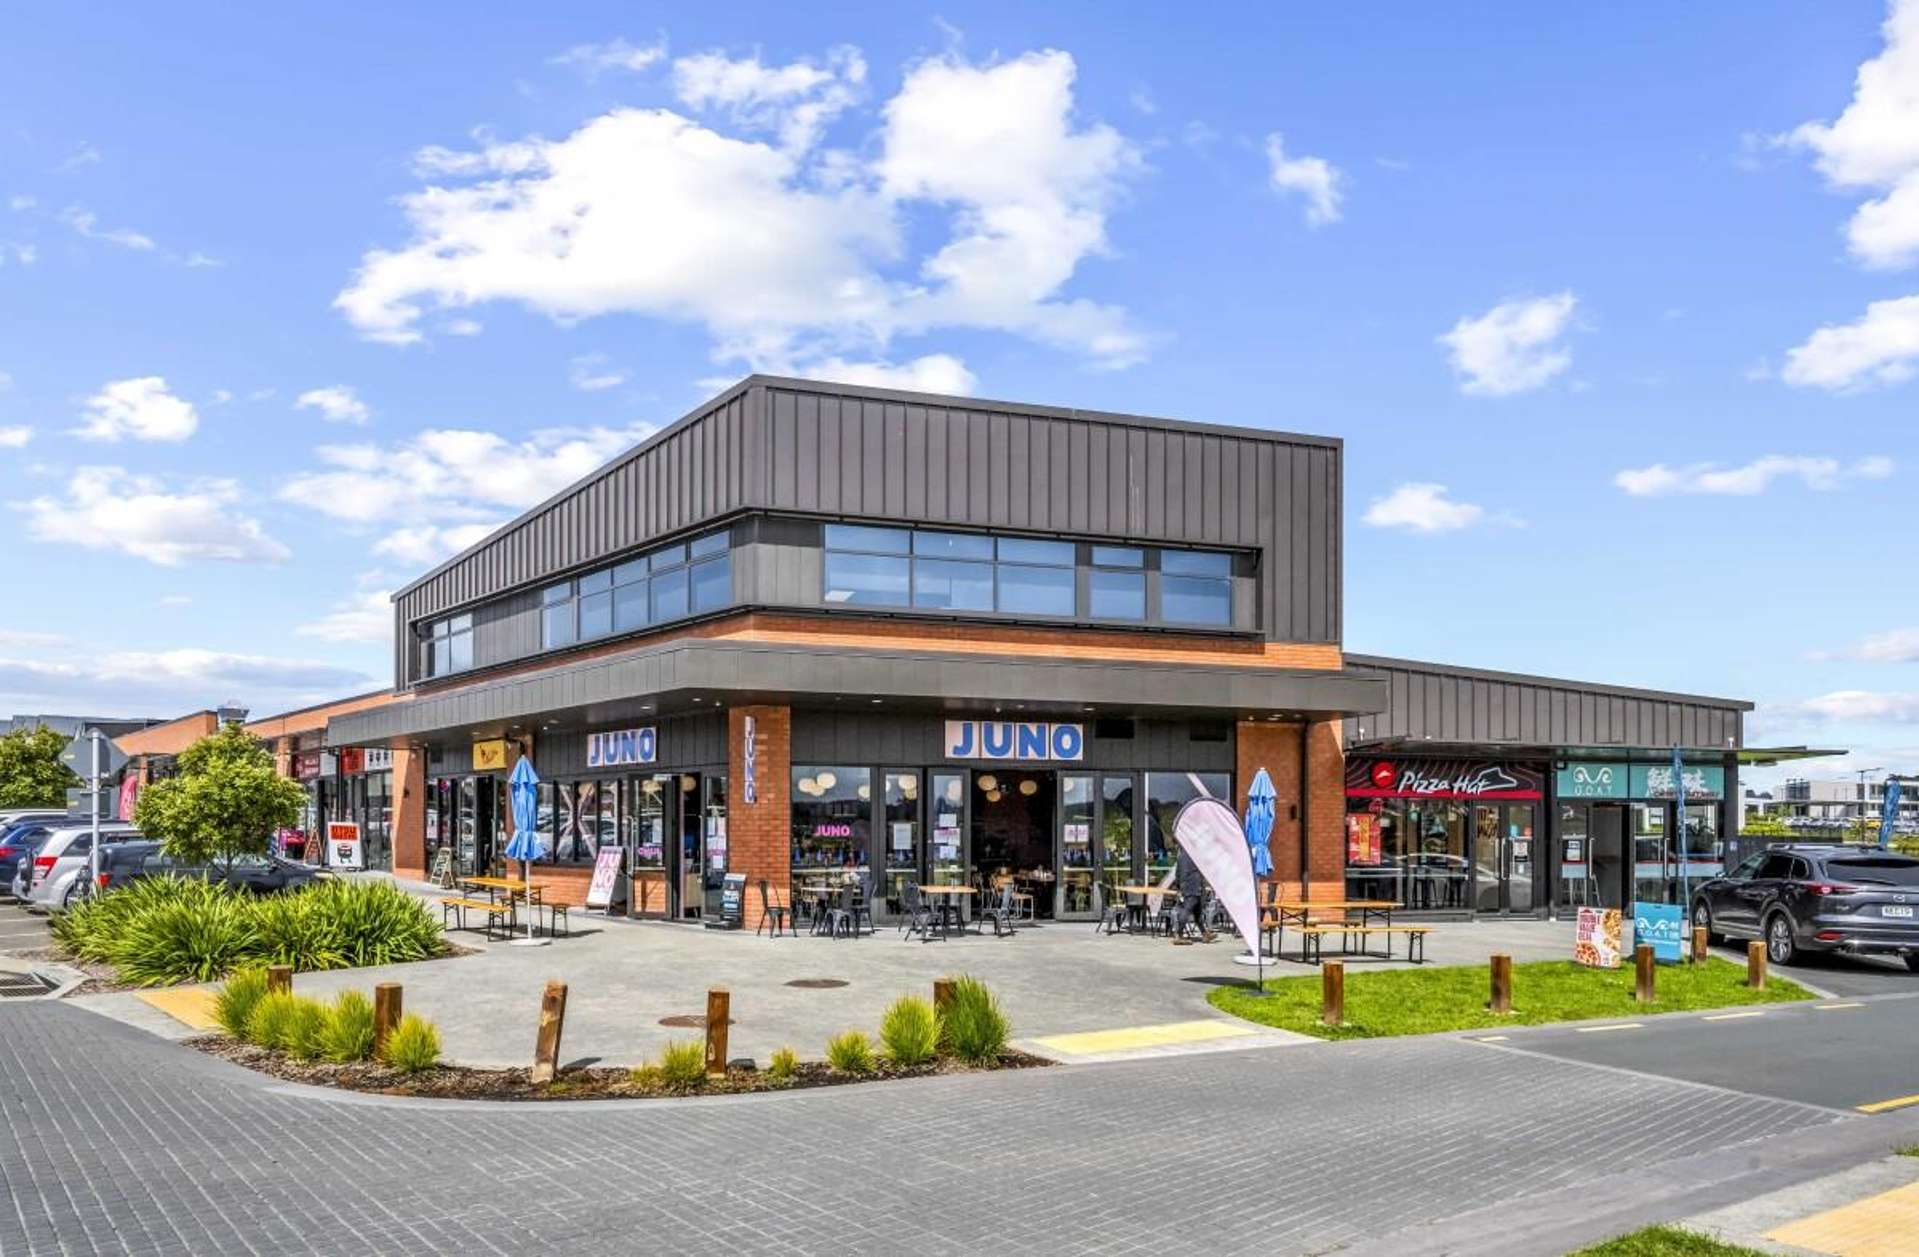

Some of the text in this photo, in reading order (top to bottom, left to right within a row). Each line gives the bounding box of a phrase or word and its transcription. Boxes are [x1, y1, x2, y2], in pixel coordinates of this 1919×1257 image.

[590, 729, 655, 765] JUNO
[952, 722, 1082, 759] JUNO
[746, 717, 756, 802] JUNO
[1398, 771, 1490, 795] Pizza Hut
[814, 824, 851, 837] JUNO
